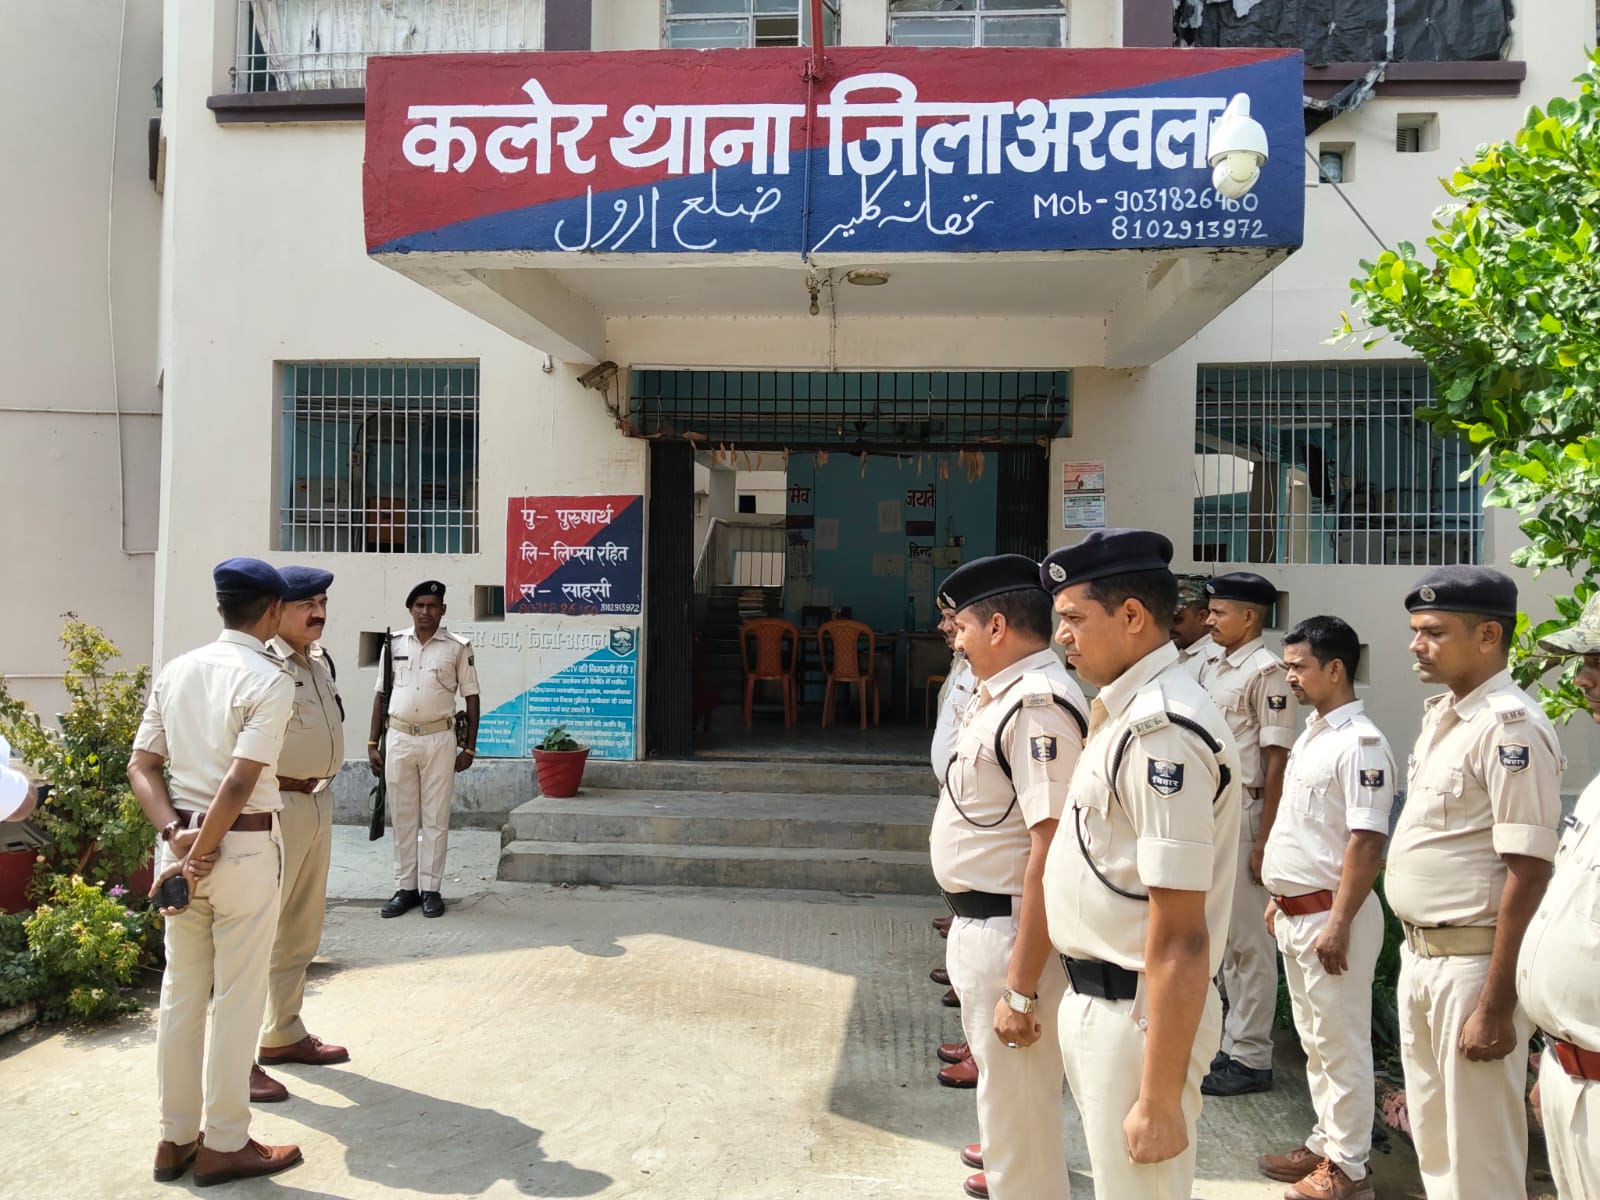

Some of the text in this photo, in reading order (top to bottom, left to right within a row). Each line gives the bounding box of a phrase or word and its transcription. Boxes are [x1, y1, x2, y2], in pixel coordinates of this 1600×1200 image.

[402, 78, 608, 174] कलेर
[609, 103, 806, 174] थाना
[816, 72, 1015, 175] जिला
[554, 184, 660, 251] ارول
[1111, 215, 1268, 240] 8102913972
[596, 541, 630, 567] रहित
[561, 577, 613, 604] साहसी
